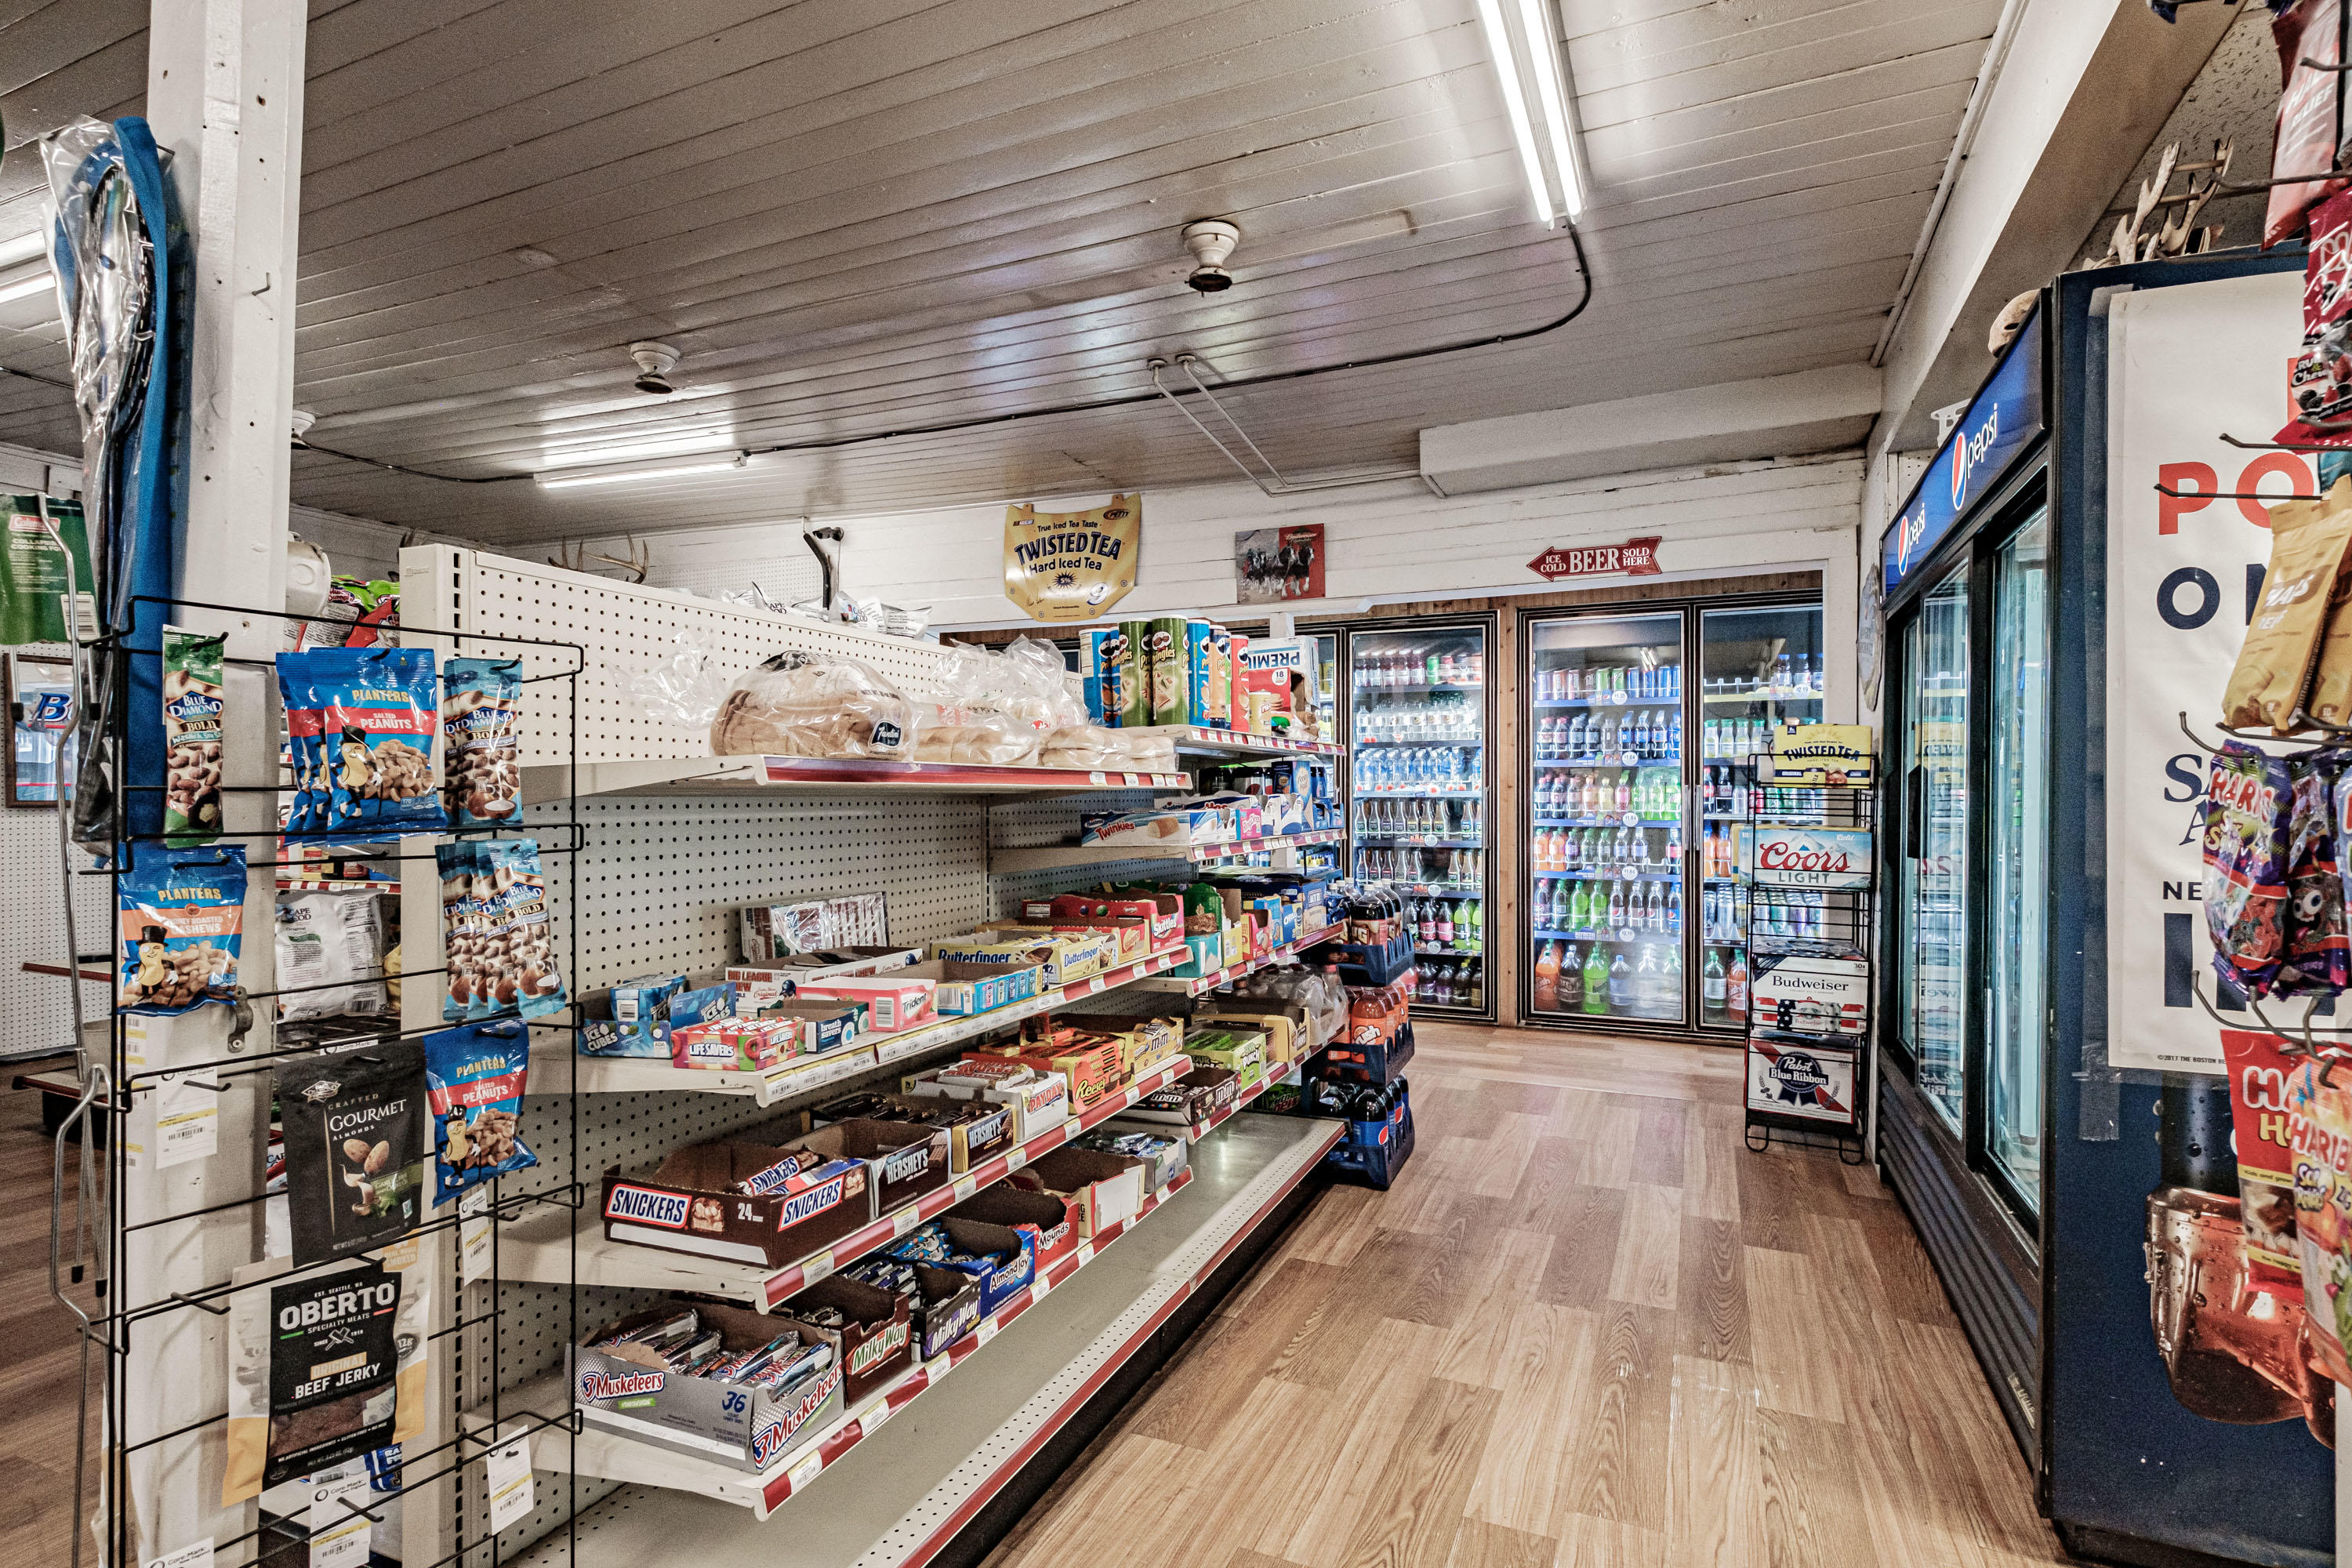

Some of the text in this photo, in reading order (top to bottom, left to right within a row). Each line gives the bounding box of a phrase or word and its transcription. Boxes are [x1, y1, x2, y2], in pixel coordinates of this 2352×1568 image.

[2292, 368, 2328, 387] Chew
[1966, 402, 1998, 480] pepsi
[1053, 521, 1067, 529] Iced
[1908, 502, 1926, 554] pepsi
[1014, 531, 1122, 565] TWISTED TEA
[1623, 547, 1650, 557] SOLD
[1029, 557, 1102, 575] Hard Iced Tea
[1541, 563, 1566, 573] COLD
[1546, 554, 1562, 563] ICE
[1570, 548, 1621, 573] BEER
[1623, 557, 1650, 567] HERE
[1087, 582, 1110, 606] 9
[1248, 652, 1300, 669] PREMIU
[183, 695, 209, 706] BLUE
[352, 689, 409, 702] PLANTERS
[169, 701, 223, 717] DIAMOND
[187, 720, 220, 731] BOLD
[360, 718, 413, 729] PEANUTS
[1783, 744, 1860, 762] TWISTED TEA
[1095, 822, 1135, 840] Twinkies
[1759, 841, 1851, 873] Coors
[1778, 871, 1831, 884] LIGHT
[158, 887, 222, 902] PLANTERS
[510, 886, 532, 897] BLUE
[2163, 880, 2202, 901] NE
[514, 903, 542, 916] BOLD
[191, 916, 223, 925] ROASTED
[1154, 918, 1177, 934] Skittles
[938, 948, 1011, 964] Butterfinger
[1064, 946, 1098, 967] Butterfinger
[728, 971, 773, 982] BIG LEAGUE
[1773, 975, 1849, 992] Budweiser
[753, 990, 778, 1000] Original
[902, 993, 927, 1012] Trident
[588, 1028, 601, 1041] ICE
[821, 1019, 842, 1032] breath
[821, 1027, 842, 1040] savers
[588, 1032, 619, 1051] CUBES
[771, 1030, 793, 1045] LIFE SAVERS
[689, 1044, 735, 1058] LIFE SAVERS
[1242, 1049, 1260, 1072] PUNCH
[456, 1058, 506, 1079] PLANTERS
[1784, 1056, 1813, 1072] Pabst
[1770, 1068, 1828, 1085] Blue Ribbon
[463, 1085, 509, 1104] PEANUTS
[1028, 1080, 1063, 1113] PAYDAY
[1075, 1076, 1106, 1101] Reese's
[328, 1092, 380, 1111] CRAFTED
[329, 1098, 408, 1132] GOURMET
[332, 1124, 376, 1142] ALMONDS
[969, 1117, 1002, 1150] HERSHEY'S
[751, 1156, 800, 1192] SNICKERS
[887, 1147, 929, 1185] HERSHEY'S
[612, 1189, 685, 1223] SNICKERS
[738, 1203, 753, 1221] 24
[784, 1186, 840, 1225] SNICKERS
[1038, 1221, 1070, 1250] Mounds
[989, 1255, 1030, 1294] Almond Joy
[279, 1282, 394, 1330] OBERTO
[307, 1312, 370, 1334] SPECIALTY MEATS
[931, 1298, 979, 1356] Milky Way
[851, 1322, 908, 1374] Milky Way
[313, 1352, 365, 1378] ORIGINAL
[295, 1376, 331, 1399] BEEF
[336, 1362, 381, 1387] JERKY
[583, 1373, 664, 1401] 3 Musketeers
[722, 1391, 747, 1413] 36
[754, 1362, 843, 1468] 3 Musketeers
[330, 1479, 364, 1494] Core-Mark
[167, 1546, 206, 1566] Core-Mark
